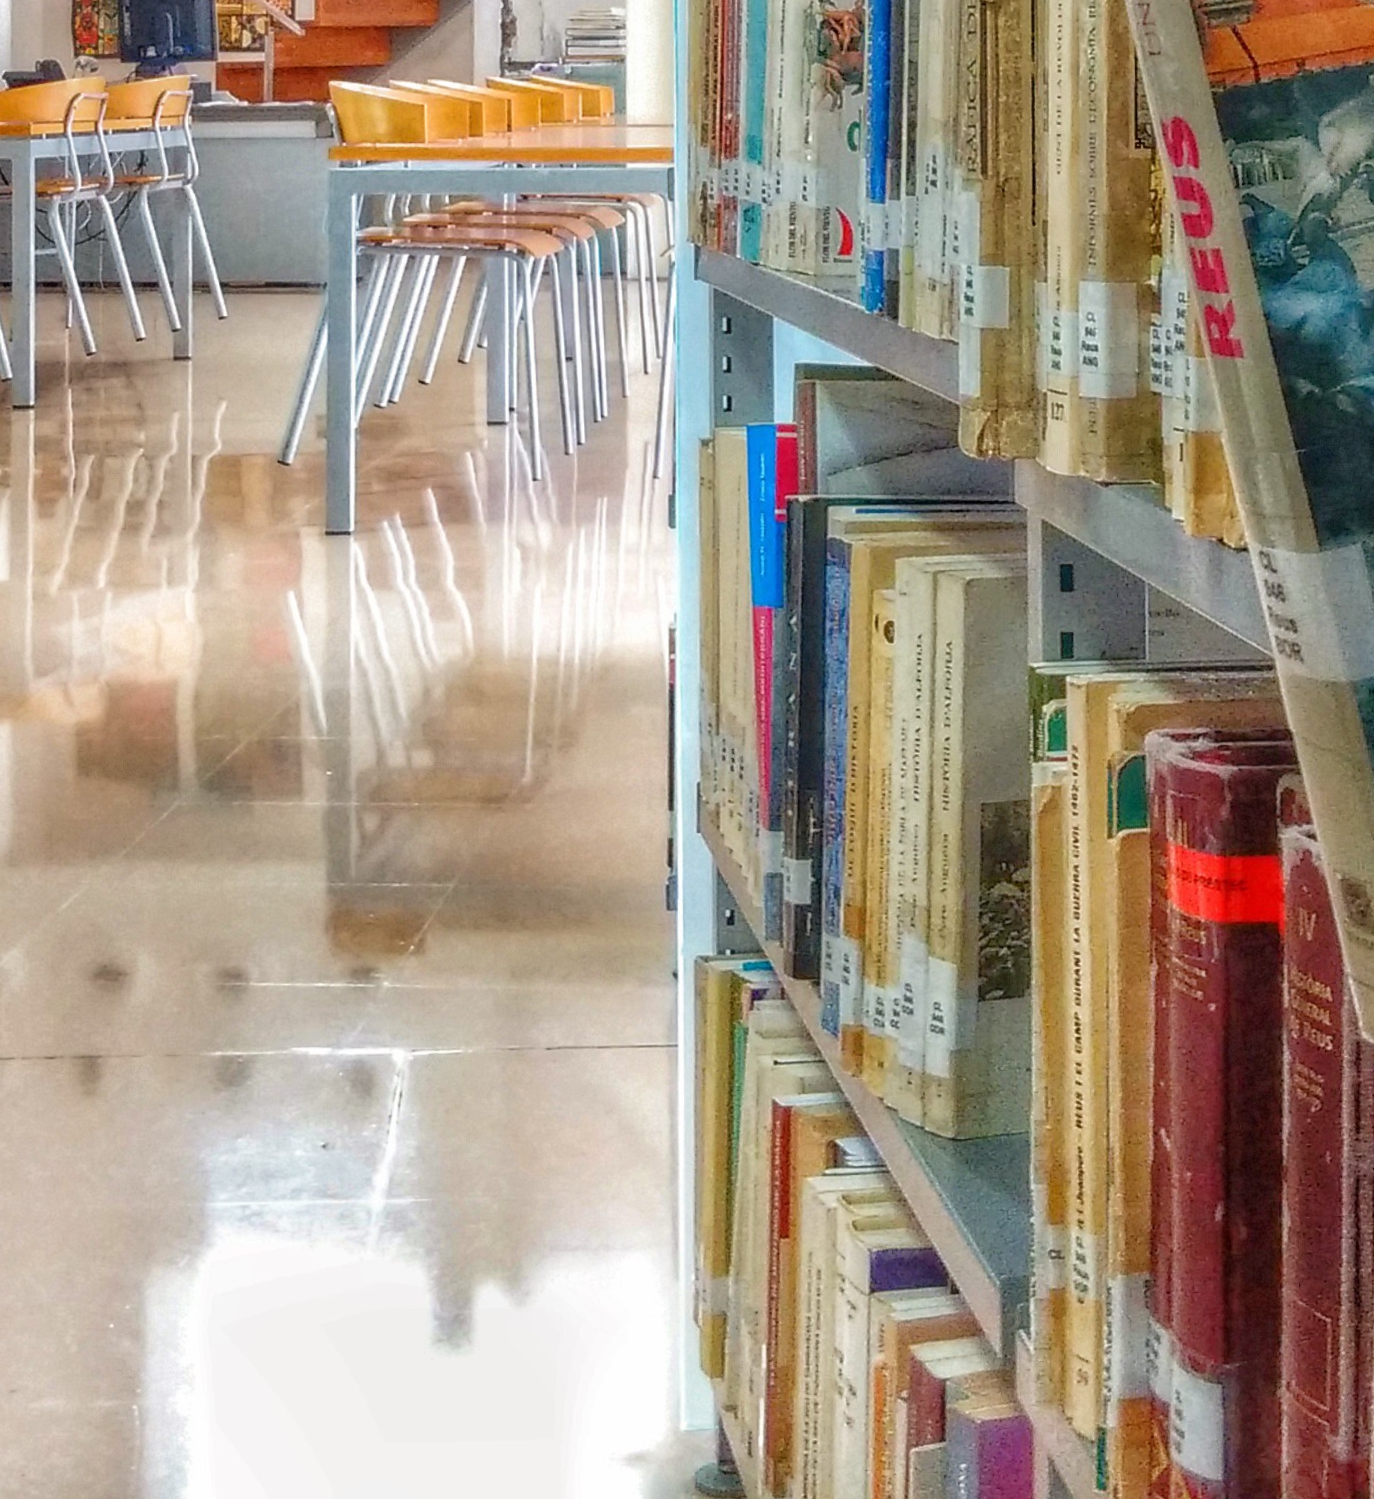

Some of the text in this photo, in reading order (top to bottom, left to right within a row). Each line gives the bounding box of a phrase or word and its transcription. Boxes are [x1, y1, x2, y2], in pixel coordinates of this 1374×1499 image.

[1131, 4, 1163, 58] UN
[1086, 131, 1099, 179] SOBRE
[1086, 186, 1099, 266] INFORMES
[1161, 114, 1246, 360] REUS
[1258, 549, 1278, 574] CL
[1071, 824, 1081, 859] CIVIL
[1071, 863, 1081, 921] GUERRA
